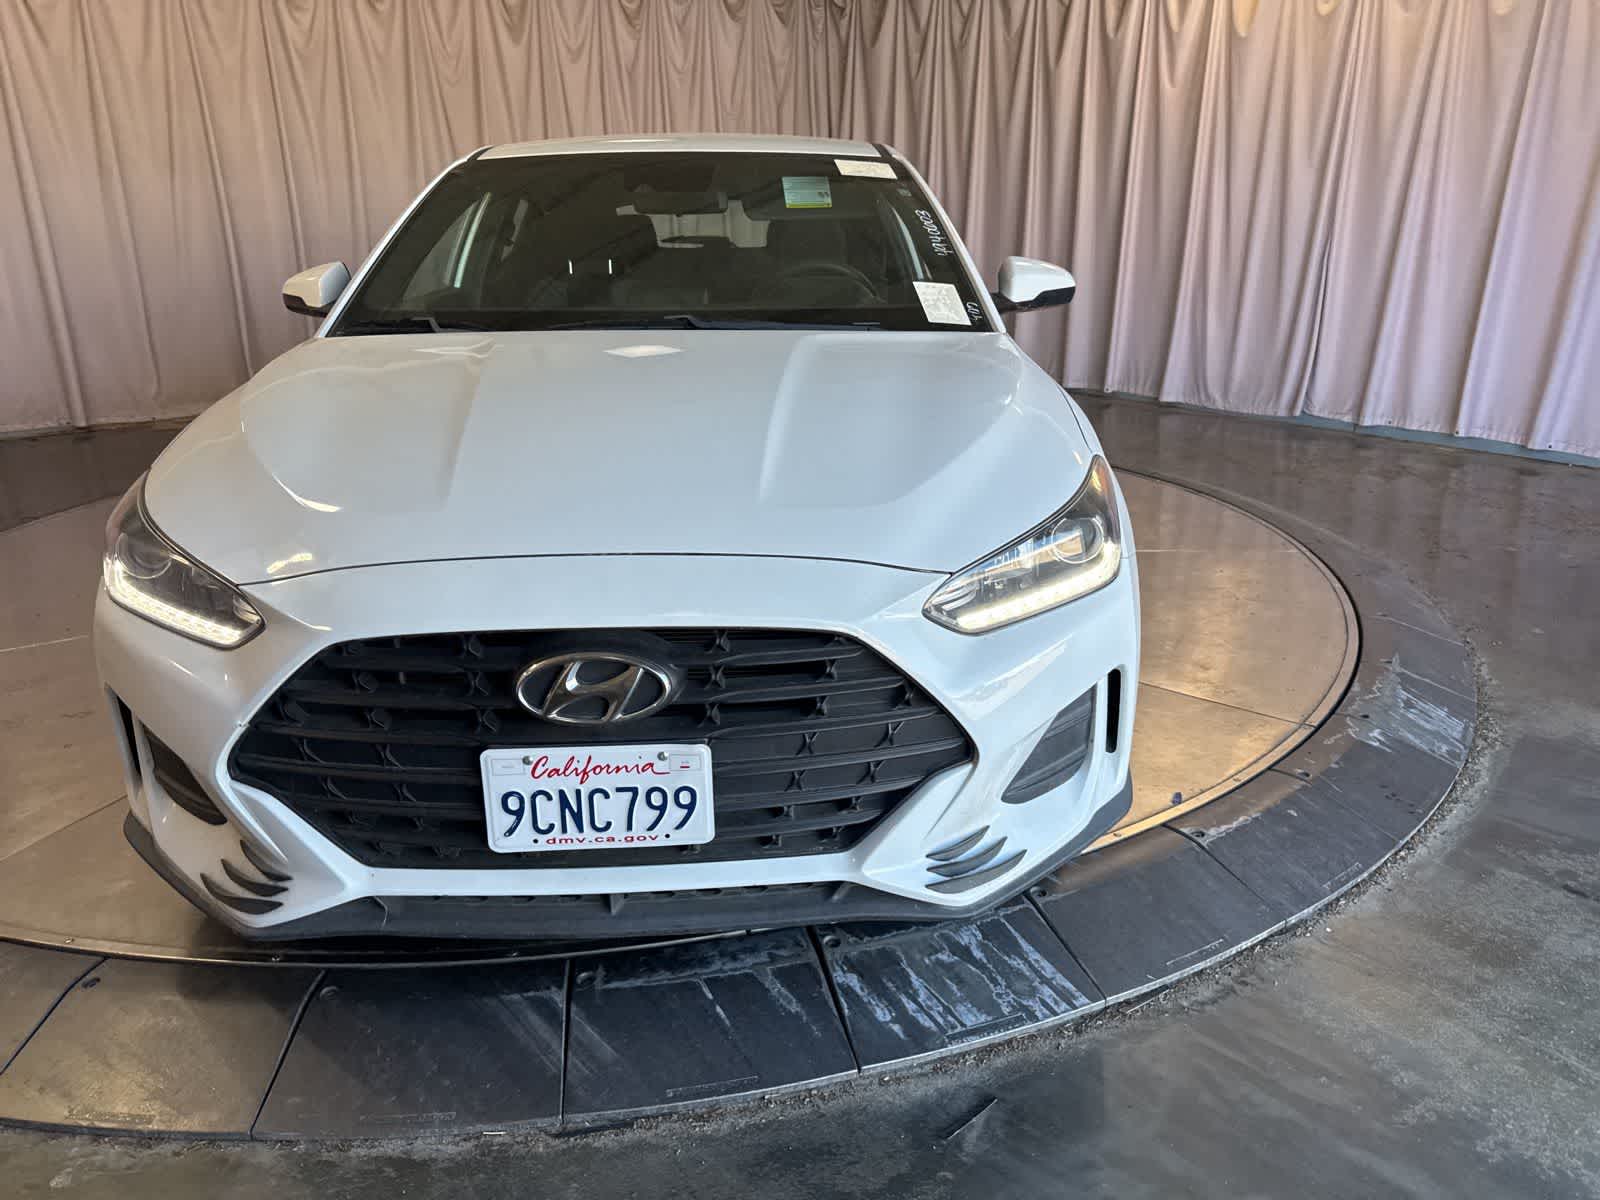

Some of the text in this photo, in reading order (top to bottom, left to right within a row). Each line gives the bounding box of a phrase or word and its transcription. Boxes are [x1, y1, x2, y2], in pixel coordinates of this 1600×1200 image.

[530, 755, 670, 785] California
[501, 785, 698, 838] 9CNC799
[546, 834, 659, 845] dmv.ca.gov
